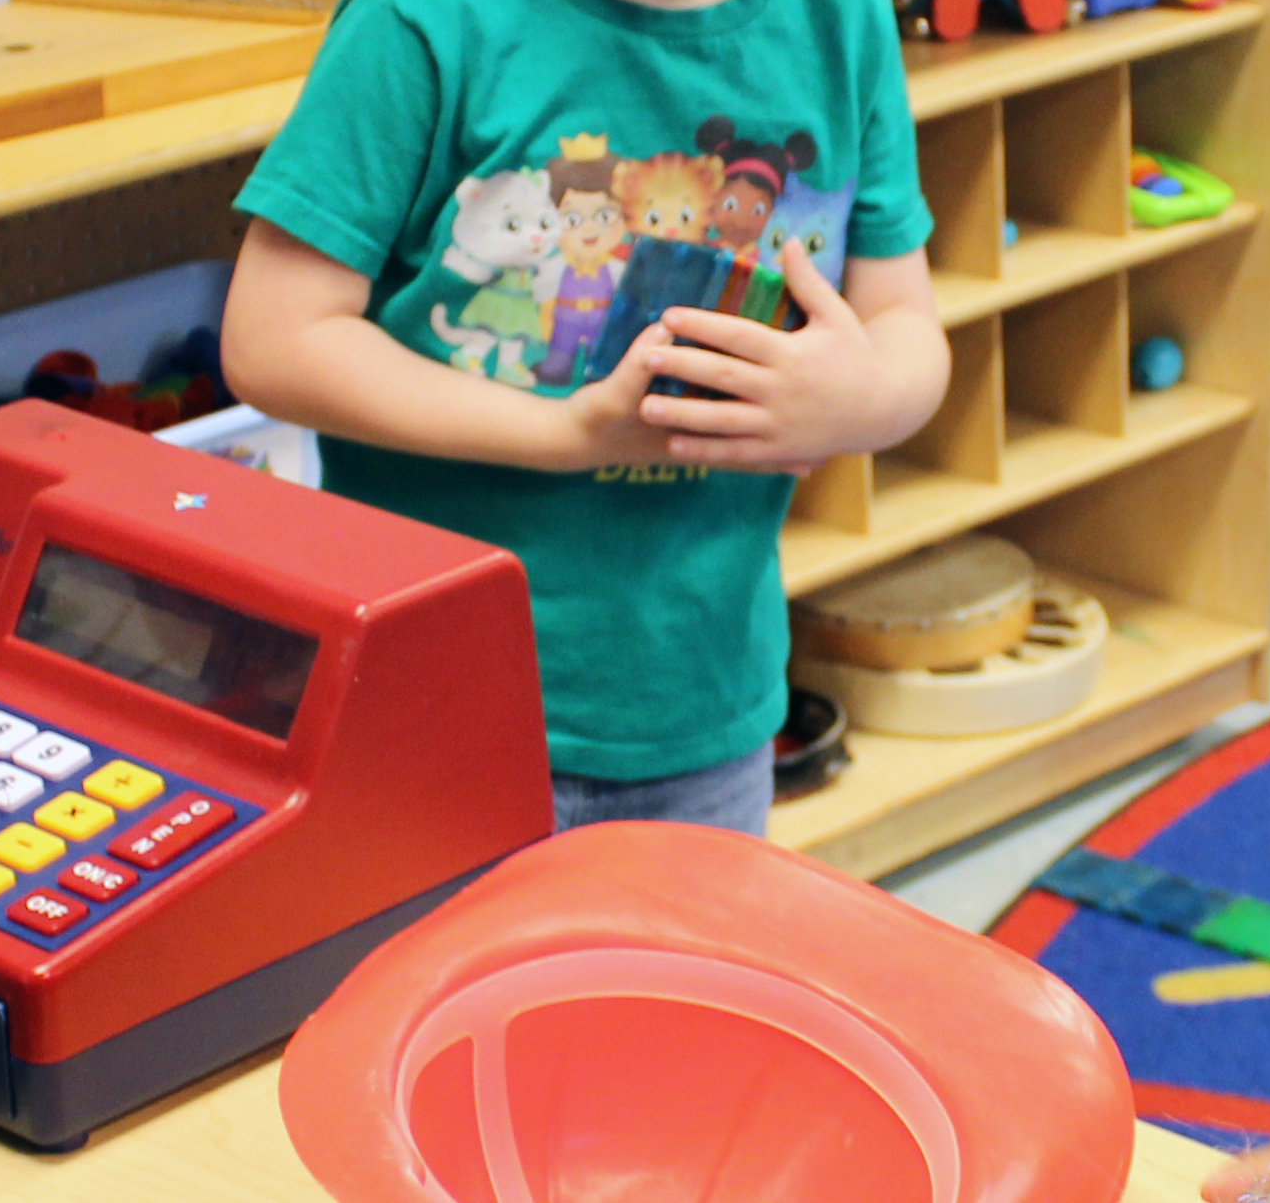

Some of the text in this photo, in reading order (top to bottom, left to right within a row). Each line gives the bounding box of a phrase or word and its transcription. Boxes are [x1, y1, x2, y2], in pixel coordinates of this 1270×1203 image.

[37, 743, 64, 761] 9
[131, 799, 211, 855] OPEN
[25, 894, 70, 919] OFF
